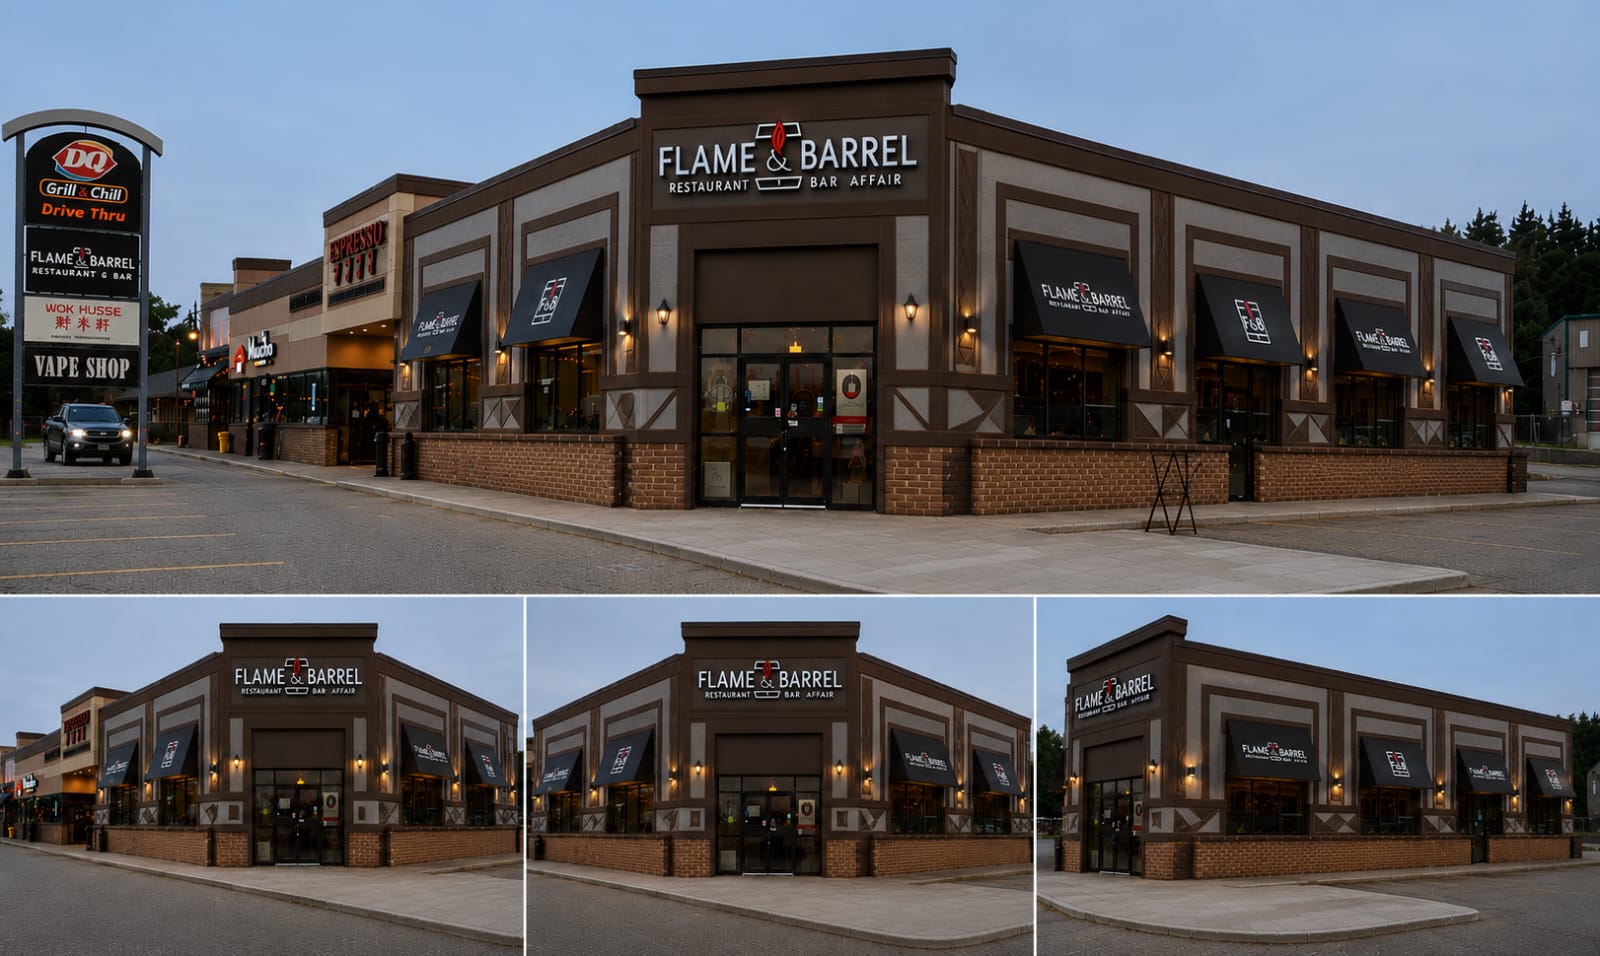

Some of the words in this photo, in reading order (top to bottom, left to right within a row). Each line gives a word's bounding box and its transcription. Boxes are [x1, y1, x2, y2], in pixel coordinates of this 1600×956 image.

[63, 148, 108, 173] DQ
[659, 142, 756, 176] FLAME
[766, 149, 793, 172] &
[801, 135, 918, 170] BARREL
[46, 183, 77, 197] Grill
[78, 187, 88, 197] &
[90, 187, 122, 201] Chill
[669, 179, 749, 193] RESTAURANT
[810, 176, 838, 188] BAR
[849, 173, 902, 186] AFFAIR
[41, 202, 85, 219] Drive
[90, 207, 126, 222] Thru
[329, 220, 383, 262] ESPRESSO
[30, 250, 74, 265] FLAME
[90, 255, 136, 270] BARREL
[32, 267, 96, 278] RESTAURANT
[113, 272, 133, 281] BAR
[1041, 283, 1080, 302] FLAME
[1091, 291, 1132, 310] BARREL
[45, 303, 74, 314] WOK
[79, 305, 122, 317] HUSSE
[34, 355, 79, 378] VAPE
[86, 357, 130, 379] SHOP
[235, 667, 286, 685] FLAME
[308, 667, 363, 685] BARREL
[698, 670, 755, 688] FLAME
[780, 670, 843, 688] BARREL
[1075, 689, 1104, 712] FLAME
[1115, 673, 1154, 701] BARREL
